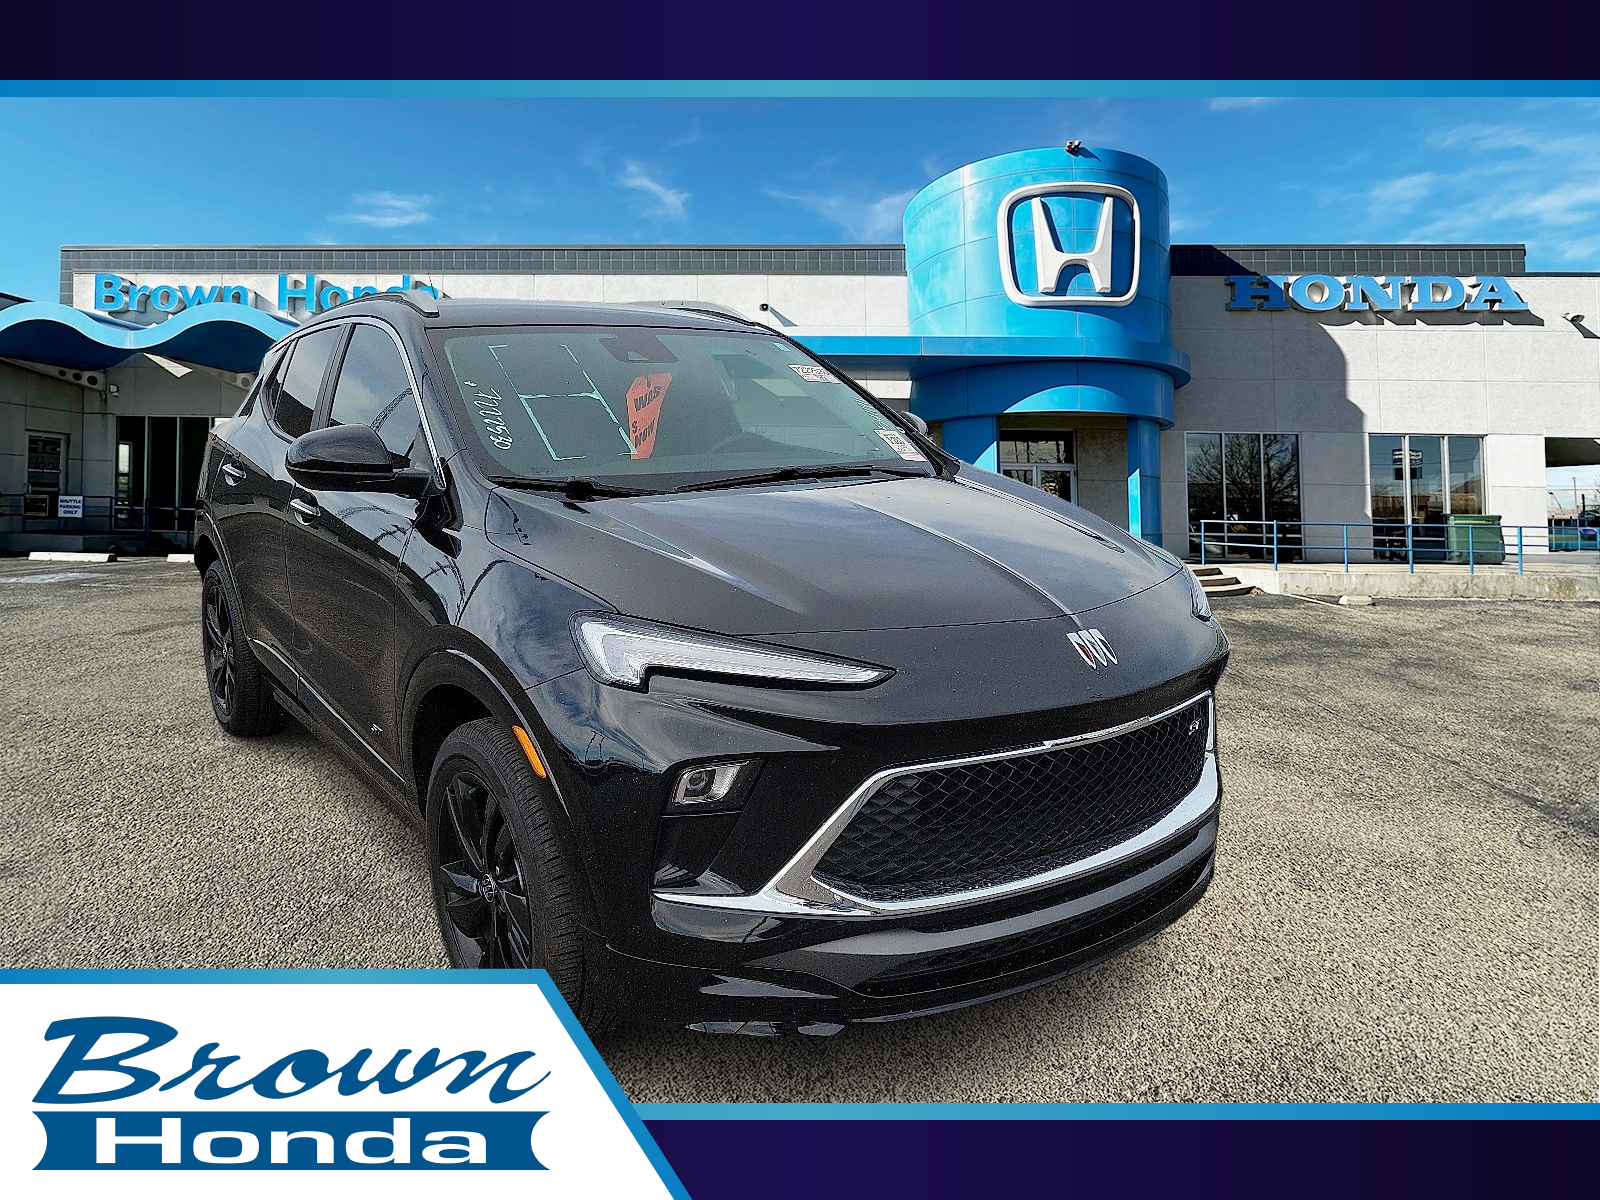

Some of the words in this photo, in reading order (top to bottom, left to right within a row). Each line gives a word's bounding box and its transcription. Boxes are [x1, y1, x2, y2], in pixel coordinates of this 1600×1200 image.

[94, 273, 249, 311] Brown
[1226, 274, 1529, 311] HONDA
[633, 386, 663, 412] WAS
[634, 418, 656, 449] NOW
